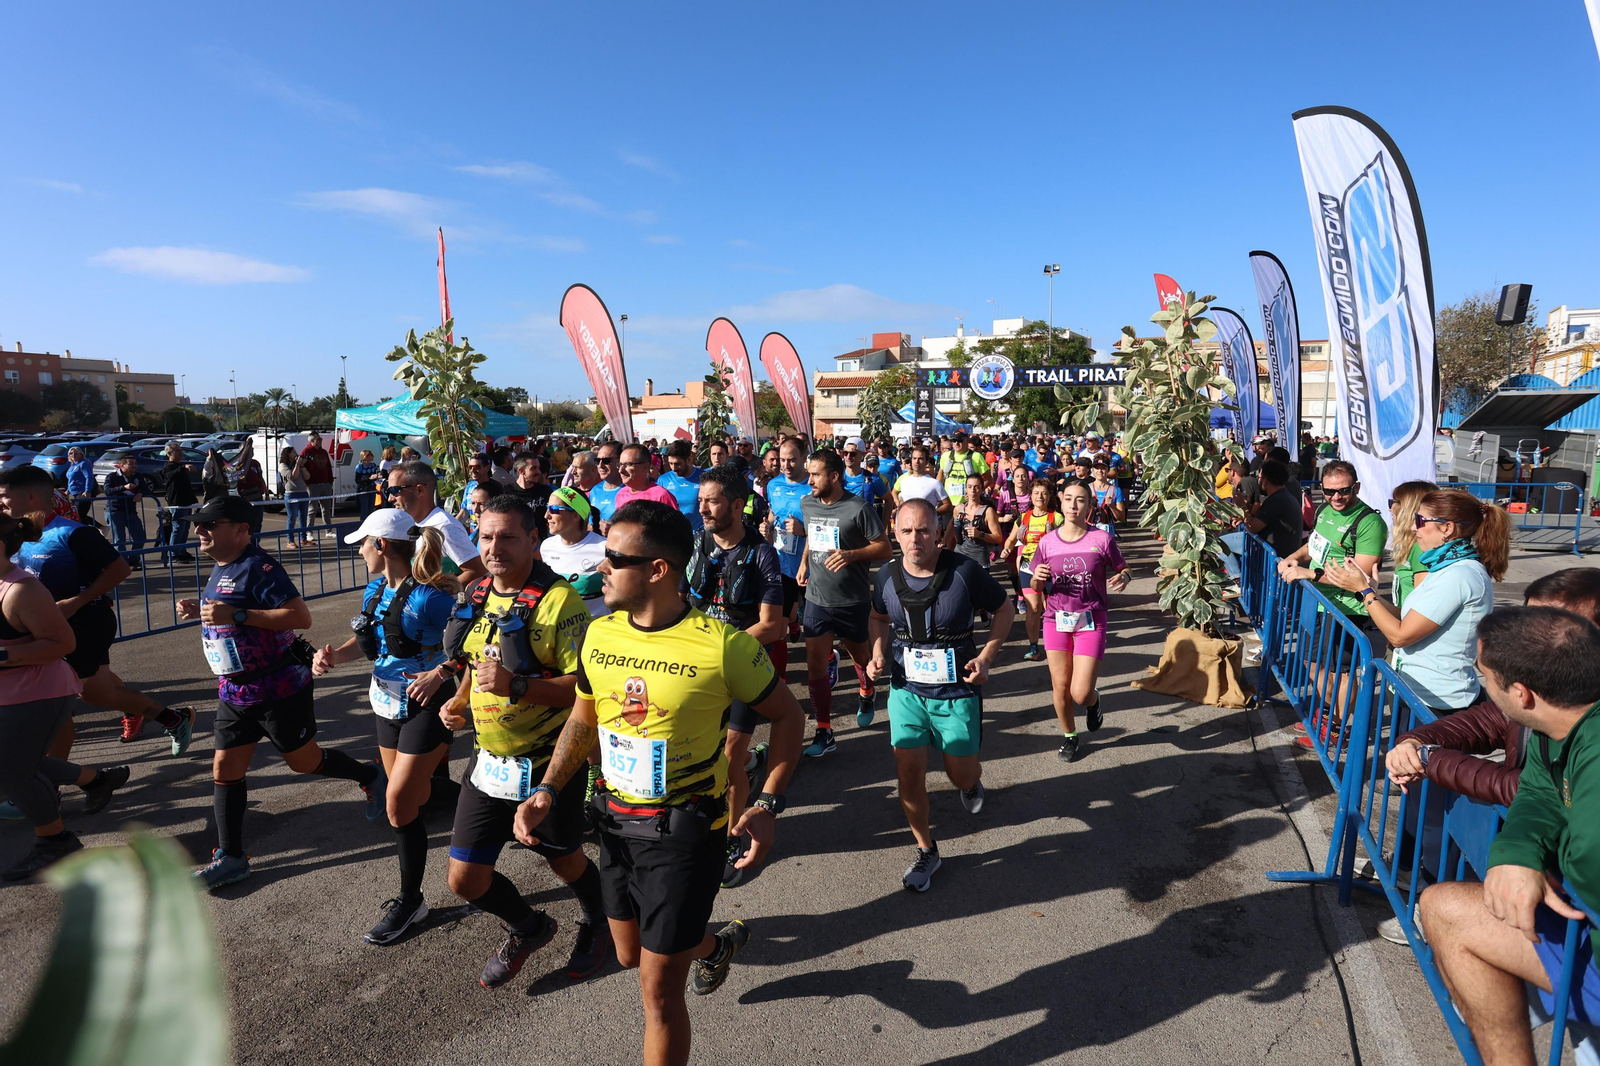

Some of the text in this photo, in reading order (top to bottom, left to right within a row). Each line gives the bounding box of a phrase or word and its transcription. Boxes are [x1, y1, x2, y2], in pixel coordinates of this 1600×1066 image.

[1026, 367, 1127, 383] TRAIL PIRAT
[814, 533, 830, 542] 738
[589, 648, 699, 678] Paparunners
[913, 660, 938, 672] 943
[373, 689, 391, 705] 822
[609, 749, 638, 774] 857
[653, 743, 663, 795] PIRATILLA
[484, 761, 510, 782] 945
